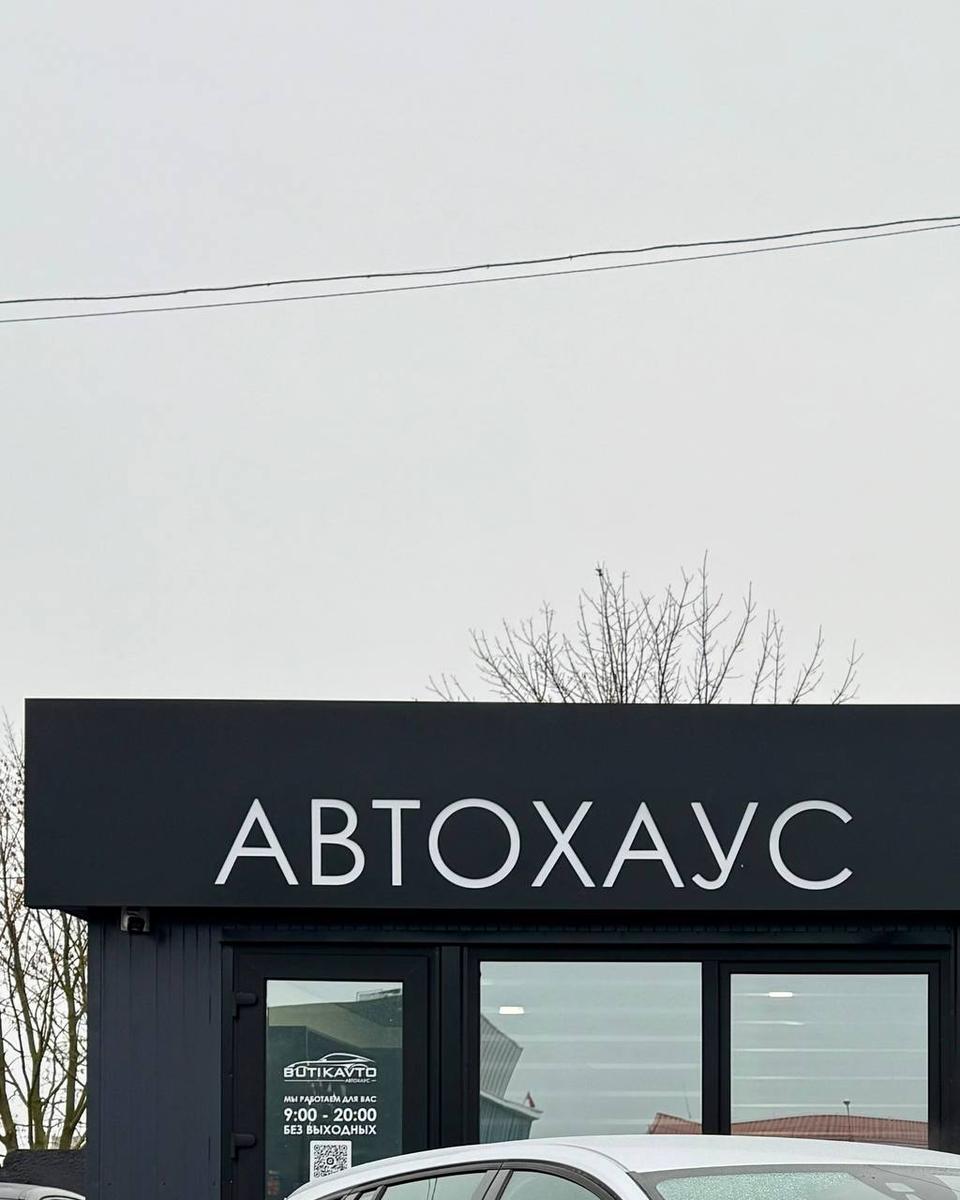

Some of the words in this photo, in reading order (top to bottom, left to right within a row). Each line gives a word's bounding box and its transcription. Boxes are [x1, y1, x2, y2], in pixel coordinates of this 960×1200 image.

[214, 798, 853, 890] АВТОХАУС
[283, 1067, 377, 1078] BUTIKAVTO
[283, 1108, 317, 1122] 9:00
[333, 1108, 377, 1122] 20:00
[283, 1125, 303, 1135] БЕЗ
[306, 1125, 377, 1136] ВЫХОДНЫХ
